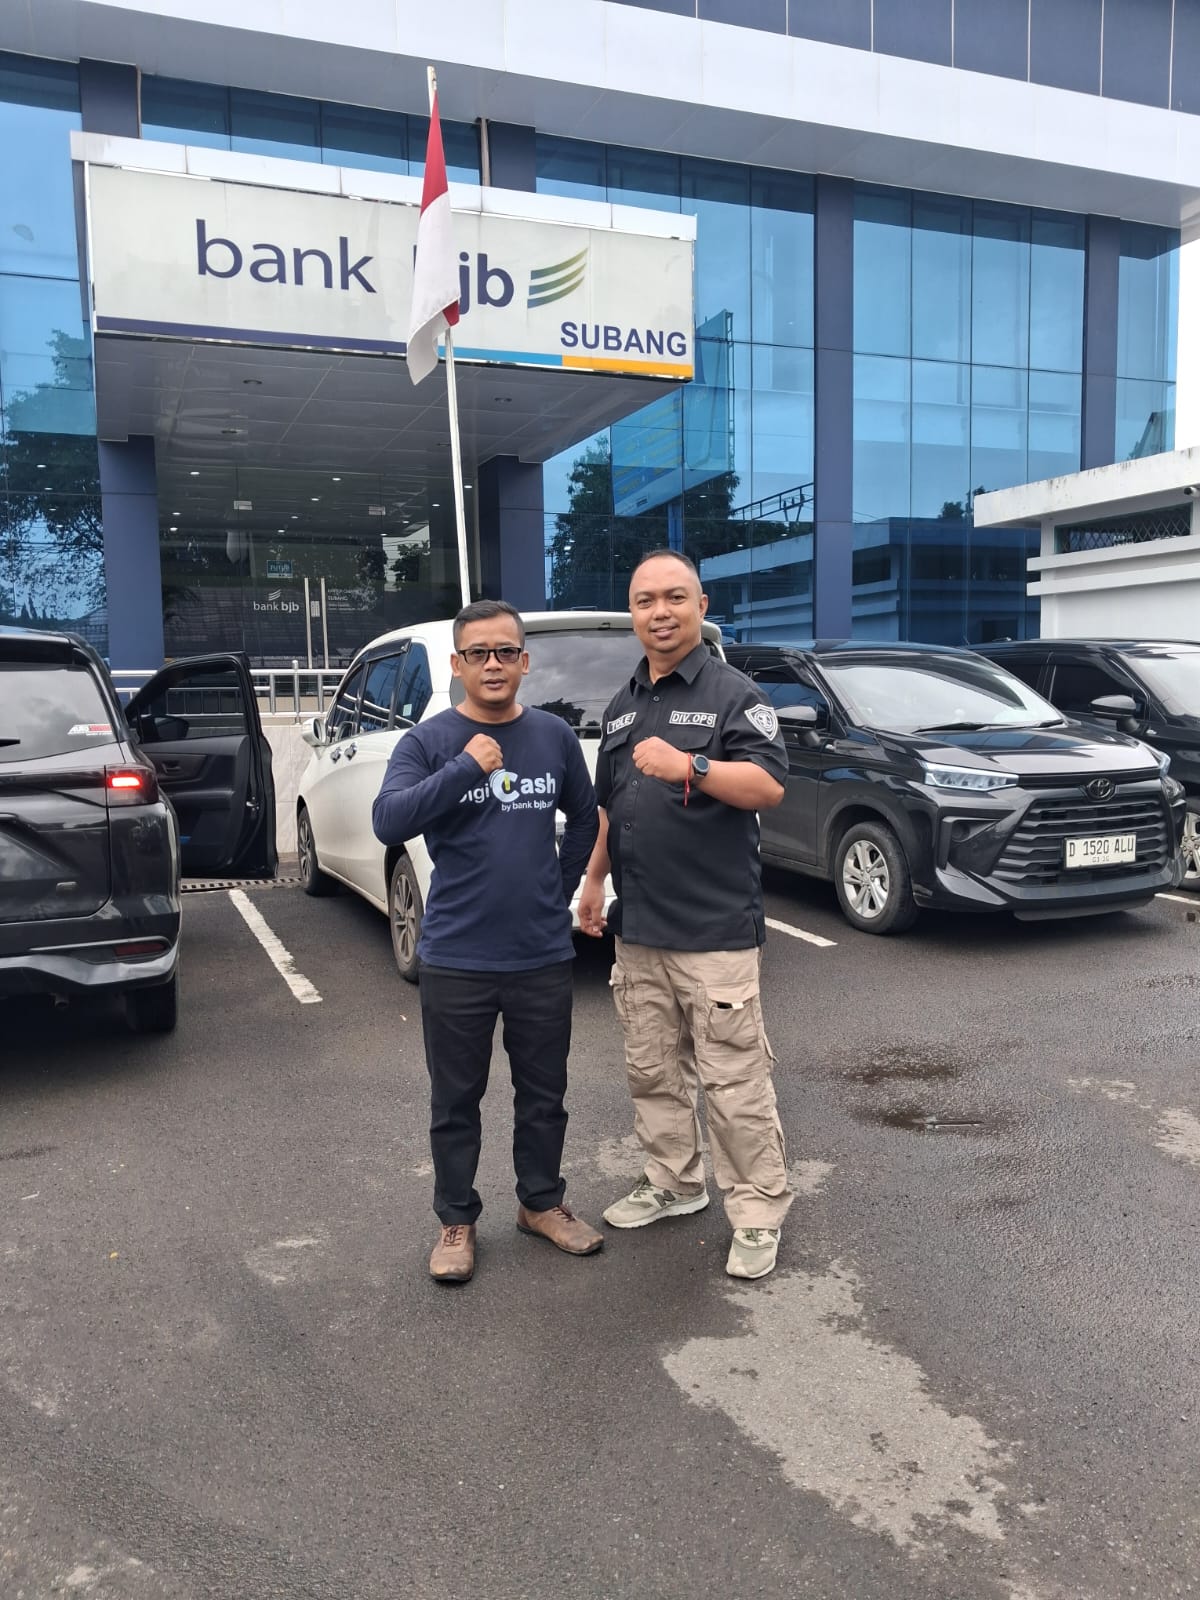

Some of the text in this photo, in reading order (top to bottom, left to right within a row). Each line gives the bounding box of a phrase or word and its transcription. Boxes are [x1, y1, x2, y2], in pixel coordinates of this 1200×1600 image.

[196, 219, 514, 315] bank jb
[560, 321, 687, 357] SUBANG
[253, 601, 300, 613] bank bjb
[694, 714, 714, 726] OPS
[501, 803, 512, 812] by
[513, 801, 533, 810] bank
[1069, 837, 1134, 857] D 1520 ALU
